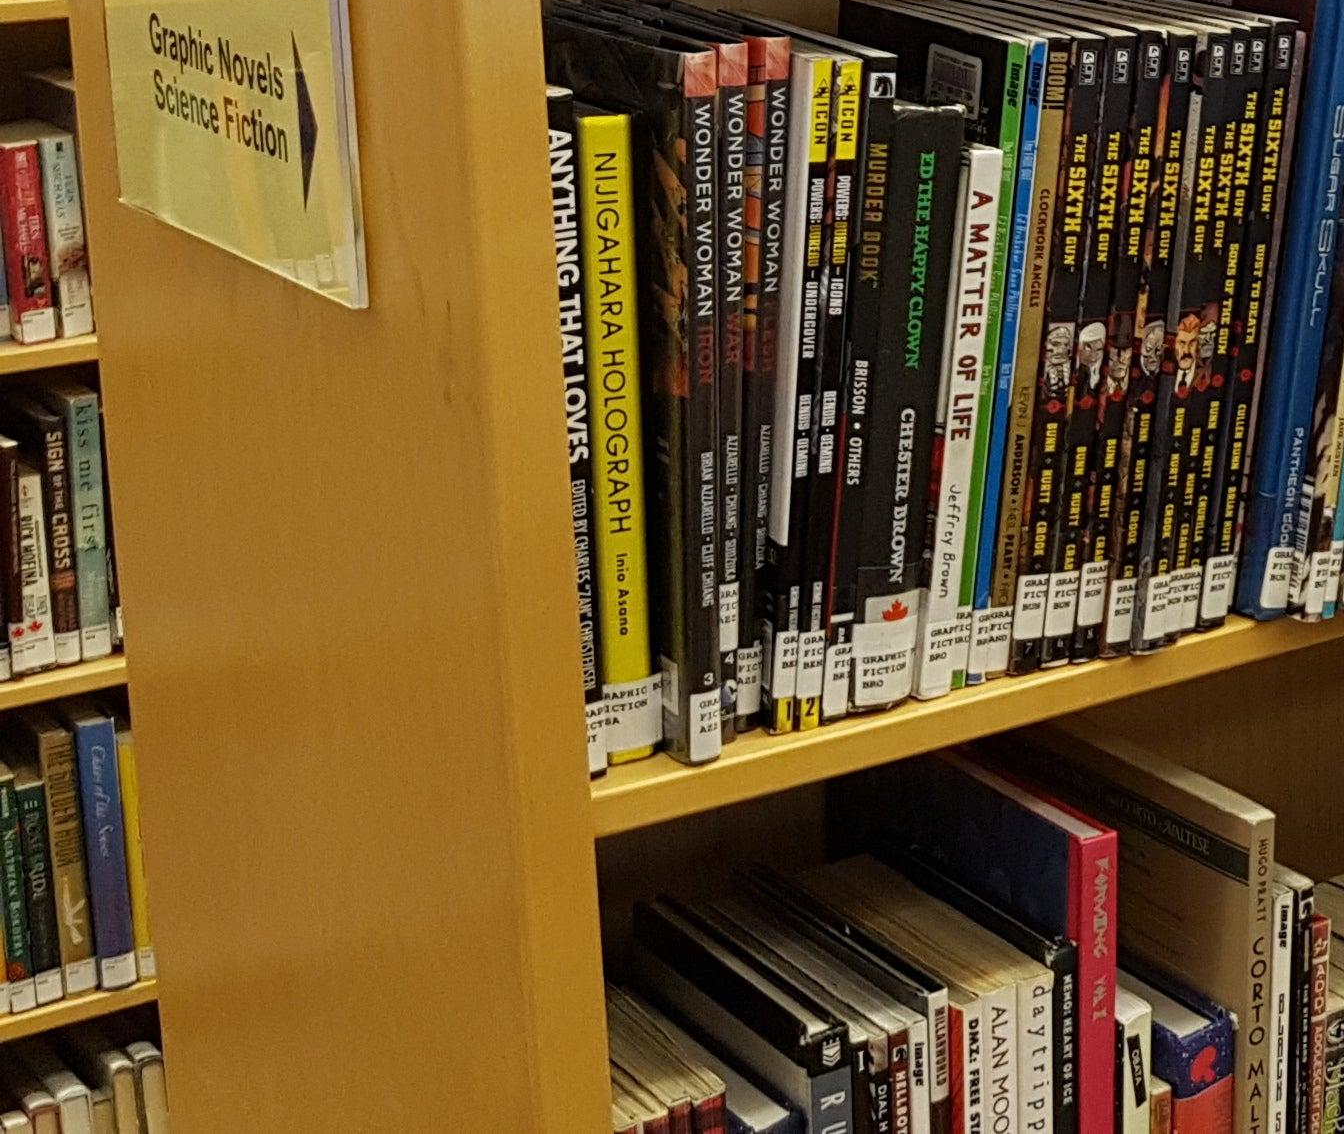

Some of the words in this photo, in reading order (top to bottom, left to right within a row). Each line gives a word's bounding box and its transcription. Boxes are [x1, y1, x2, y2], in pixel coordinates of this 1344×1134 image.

[148, 12, 214, 75] Graphic
[218, 36, 285, 101] Novels
[154, 69, 220, 135] Science
[223, 96, 289, 164] Fiction
[1269, 87, 1285, 116] THE
[693, 104, 714, 212] WONDER
[726, 94, 746, 202] WONDER
[917, 152, 936, 176] ED
[1073, 133, 1089, 162] THE
[1260, 118, 1284, 183] SIXTH
[547, 128, 579, 288] ANYTHING
[915, 178, 933, 214] THE
[972, 189, 993, 209] A
[1064, 166, 1088, 233] SIXTH
[1260, 185, 1274, 214] GUN
[593, 152, 628, 340] NIJIGAHARA
[695, 221, 714, 317] WOMAN
[725, 210, 745, 302] WOMAN
[909, 222, 929, 289] HAPPY
[1064, 236, 1079, 265] GUN
[955, 223, 989, 341] MATTER
[1308, 219, 1335, 327] SKULL
[558, 294, 585, 372] THAT
[905, 295, 926, 367] CLOWN
[956, 355, 978, 385] OF
[76, 405, 94, 447] kiss
[563, 376, 590, 463] LOVES
[600, 350, 633, 534] HOLOGRAPH
[949, 392, 974, 442] LIFE
[45, 431, 64, 471] SIGN
[79, 460, 93, 492] me
[893, 407, 917, 498] CHESTER
[53, 475, 63, 488] OF
[54, 490, 64, 511] THE
[81, 504, 99, 553] first
[940, 484, 964, 546] Jeffrey
[52, 514, 70, 568] CROSS
[888, 504, 910, 583] BROWN
[615, 553, 630, 583] Inio
[939, 552, 958, 599] Brown
[616, 587, 632, 636] Asano
[1061, 974, 1075, 1016] NEMO:
[1061, 1018, 1075, 1061] HEART
[1061, 1081, 1074, 1105] ICE
[1062, 1063, 1075, 1079] OF
